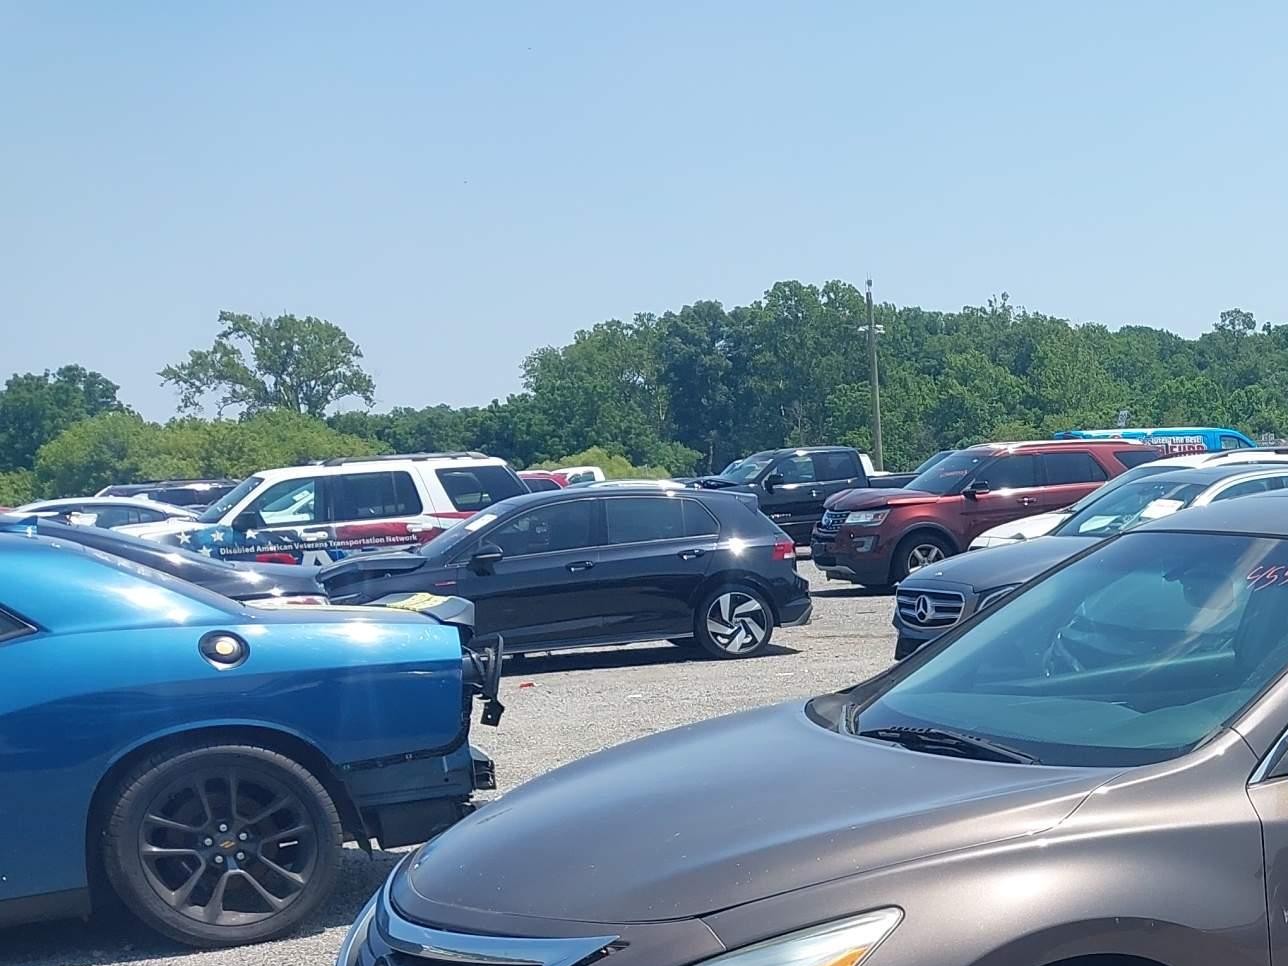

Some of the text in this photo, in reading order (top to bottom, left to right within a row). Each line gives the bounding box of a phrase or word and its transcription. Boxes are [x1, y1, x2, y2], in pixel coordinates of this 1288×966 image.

[219, 533, 418, 556] Disabled American Veterans Transportation Network
